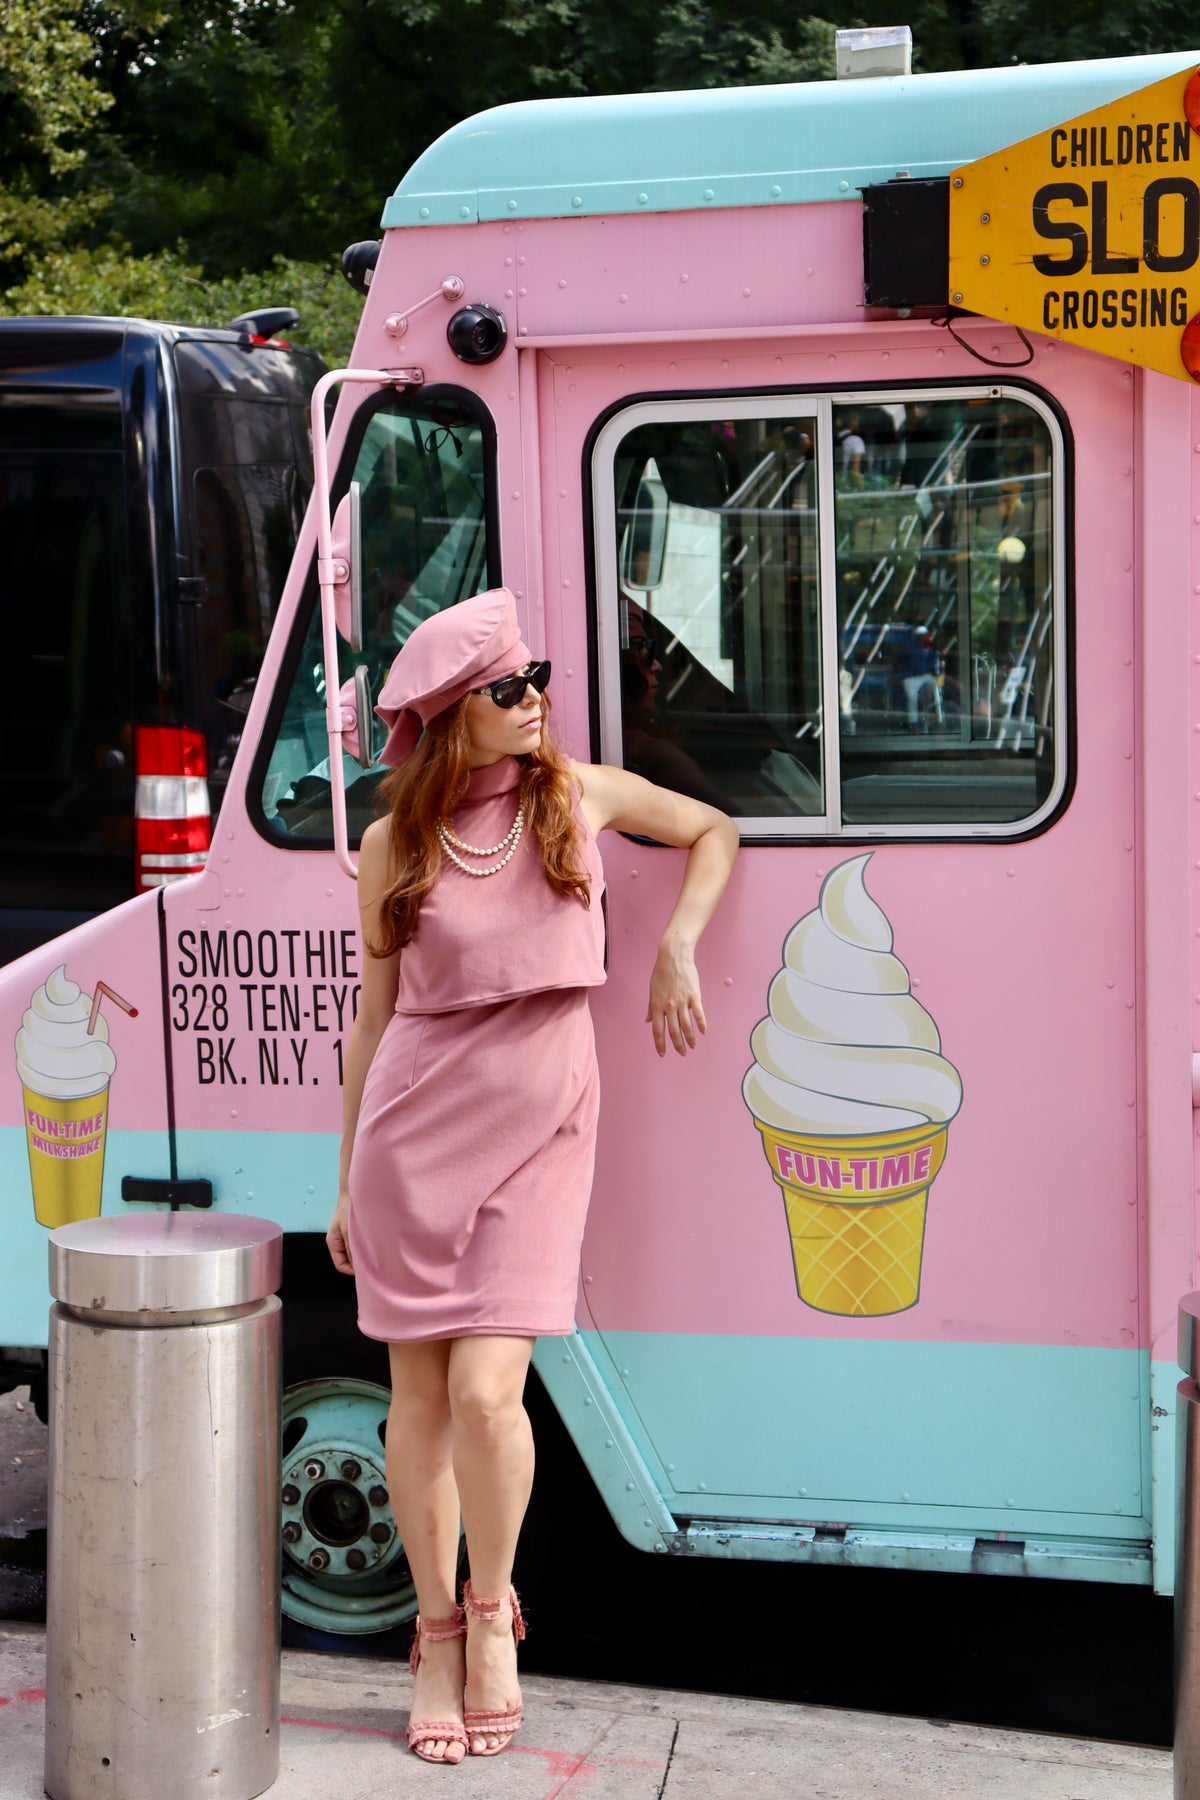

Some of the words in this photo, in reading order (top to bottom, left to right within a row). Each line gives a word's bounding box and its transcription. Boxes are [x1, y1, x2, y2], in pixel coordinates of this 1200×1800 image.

[1051, 122, 1190, 168] CHILDREN
[1043, 287, 1188, 330] CROSSING
[177, 930, 358, 978] SMOOTHIE
[172, 983, 229, 1032] 328
[196, 1037, 247, 1085] BK.
[26, 1107, 105, 1140] FUN-TIME
[31, 1132, 102, 1159] MILKSHAKE
[775, 1143, 932, 1192] FUN-TIME
